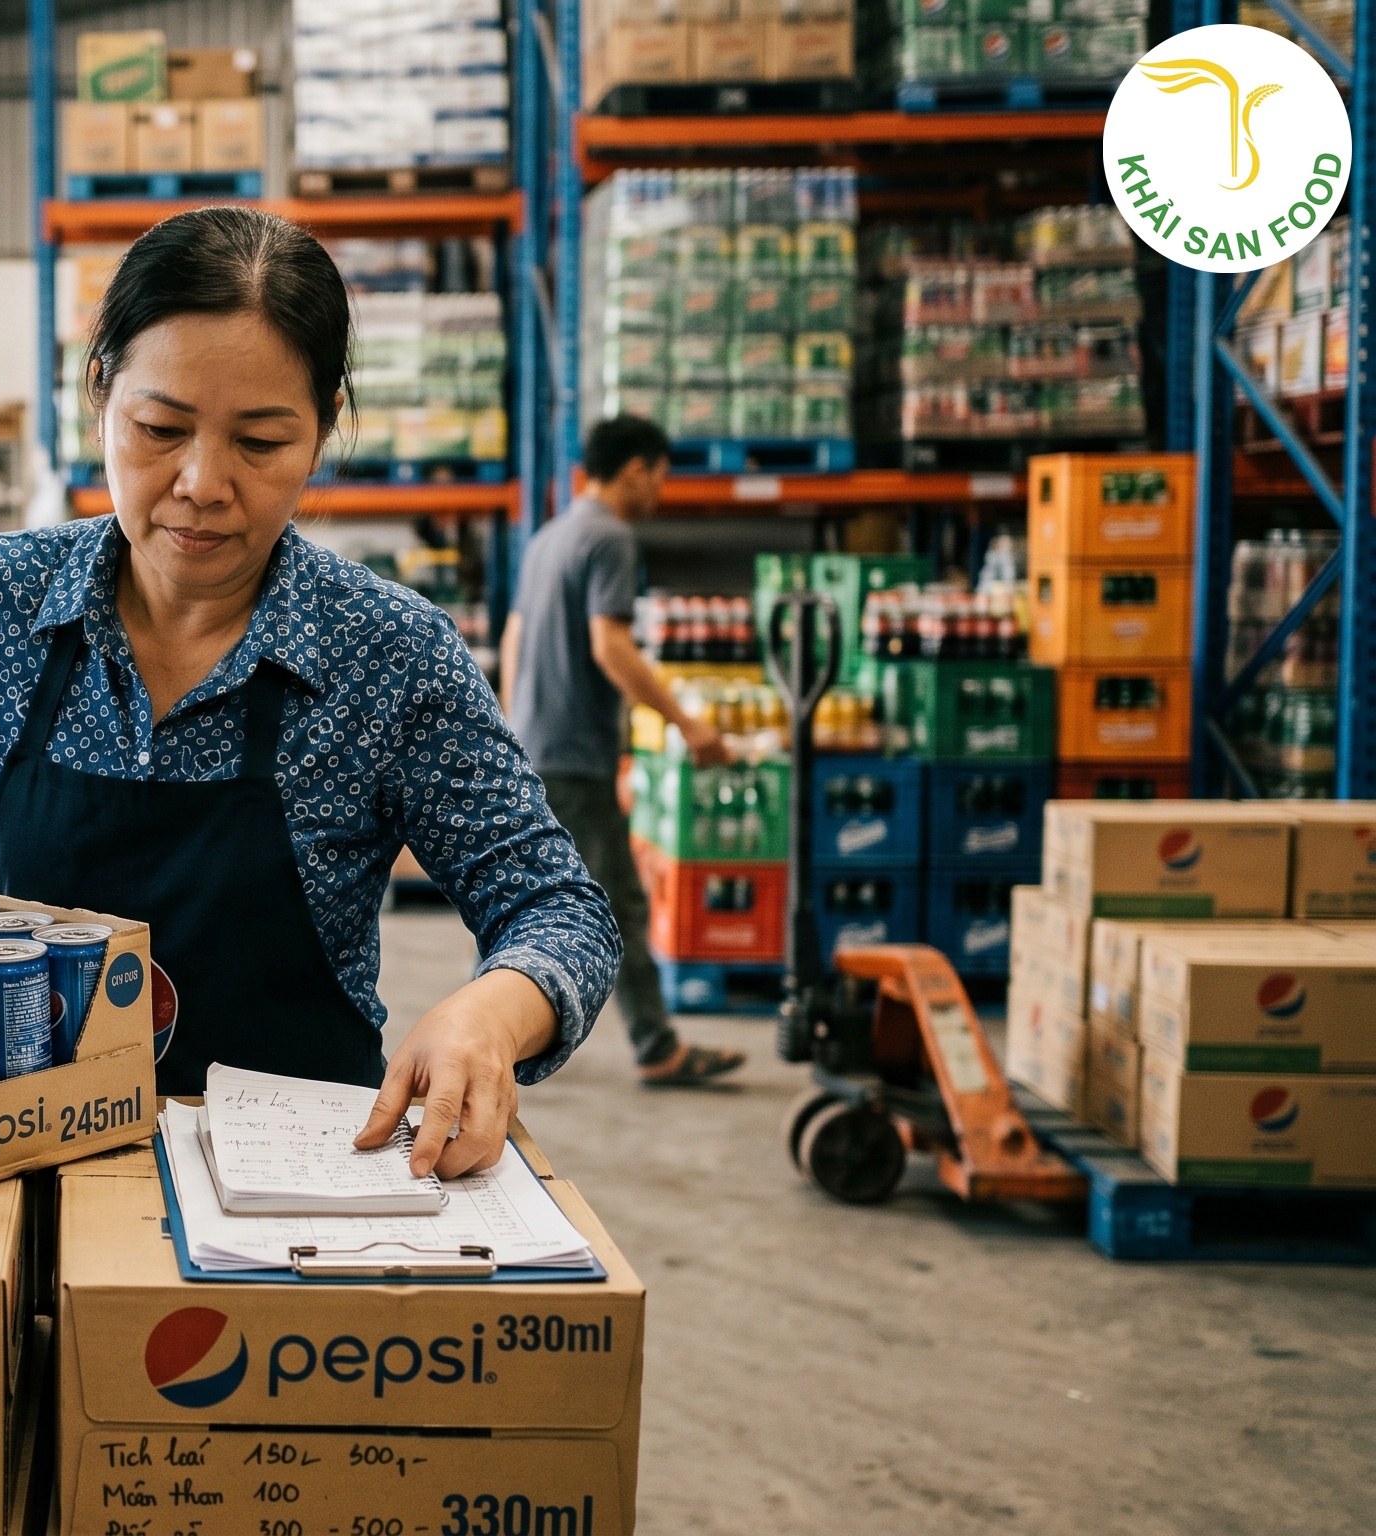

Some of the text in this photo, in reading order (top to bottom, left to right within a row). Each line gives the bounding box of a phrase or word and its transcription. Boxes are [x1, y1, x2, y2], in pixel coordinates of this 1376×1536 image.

[60, 1086, 143, 1143] 245ml
[268, 1314, 612, 1398] pepsi 330ml
[253, 1481, 300, 1504] 100
[441, 1493, 594, 1536] 330ml
